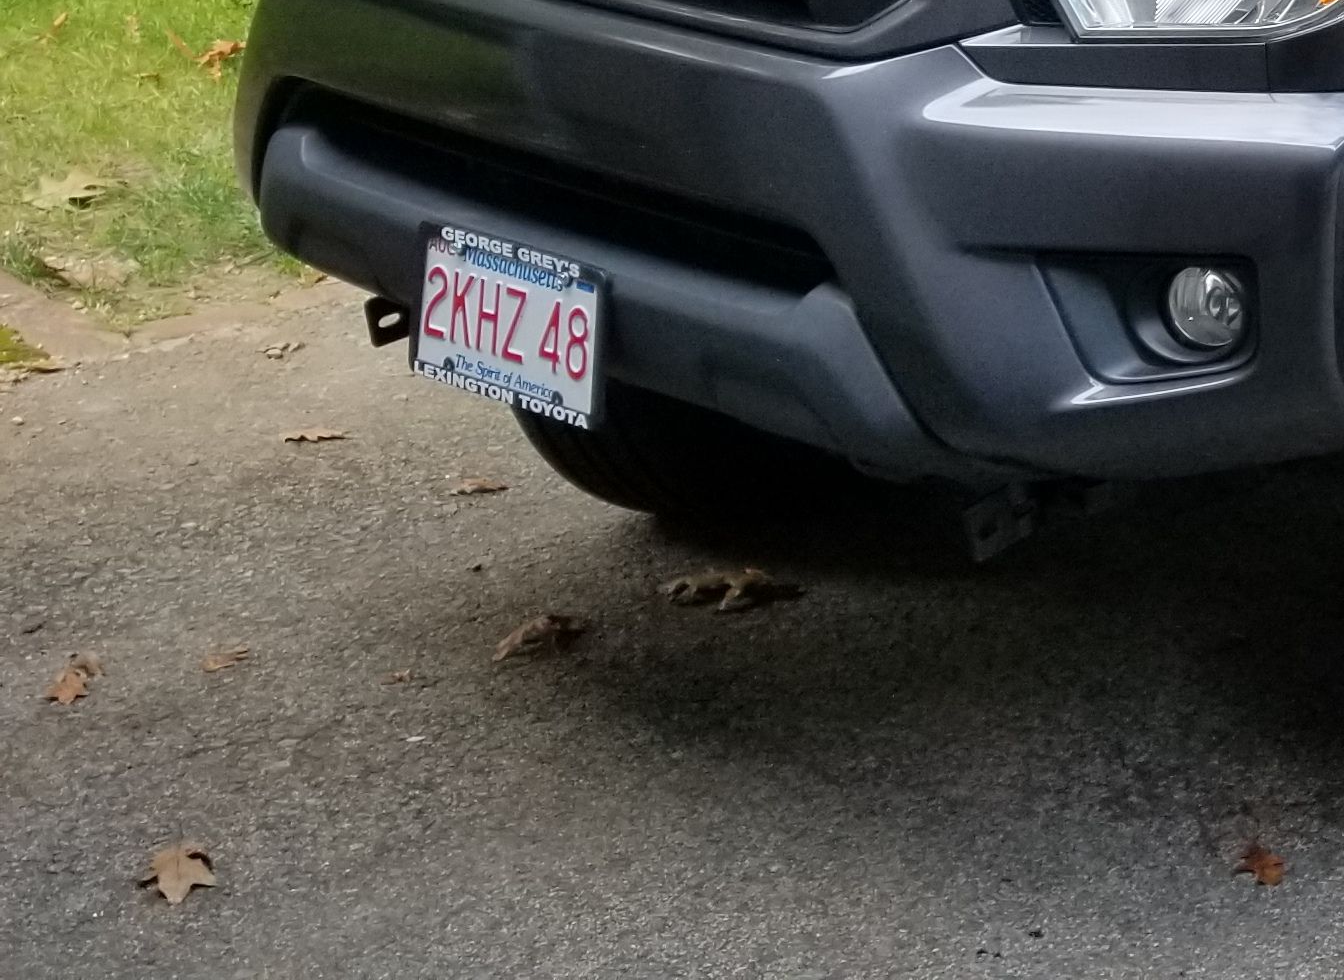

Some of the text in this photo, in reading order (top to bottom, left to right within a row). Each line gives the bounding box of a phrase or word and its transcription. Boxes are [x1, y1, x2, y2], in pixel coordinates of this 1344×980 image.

[441, 226, 580, 278] GEORGE GREY'S
[463, 248, 563, 292] Massachusetts
[423, 266, 589, 381] 2KHZ 48
[413, 360, 589, 430] LEXINGTON TOYOTA
[455, 353, 474, 372] The
[475, 360, 501, 381] Spirit
[502, 371, 514, 388] of
